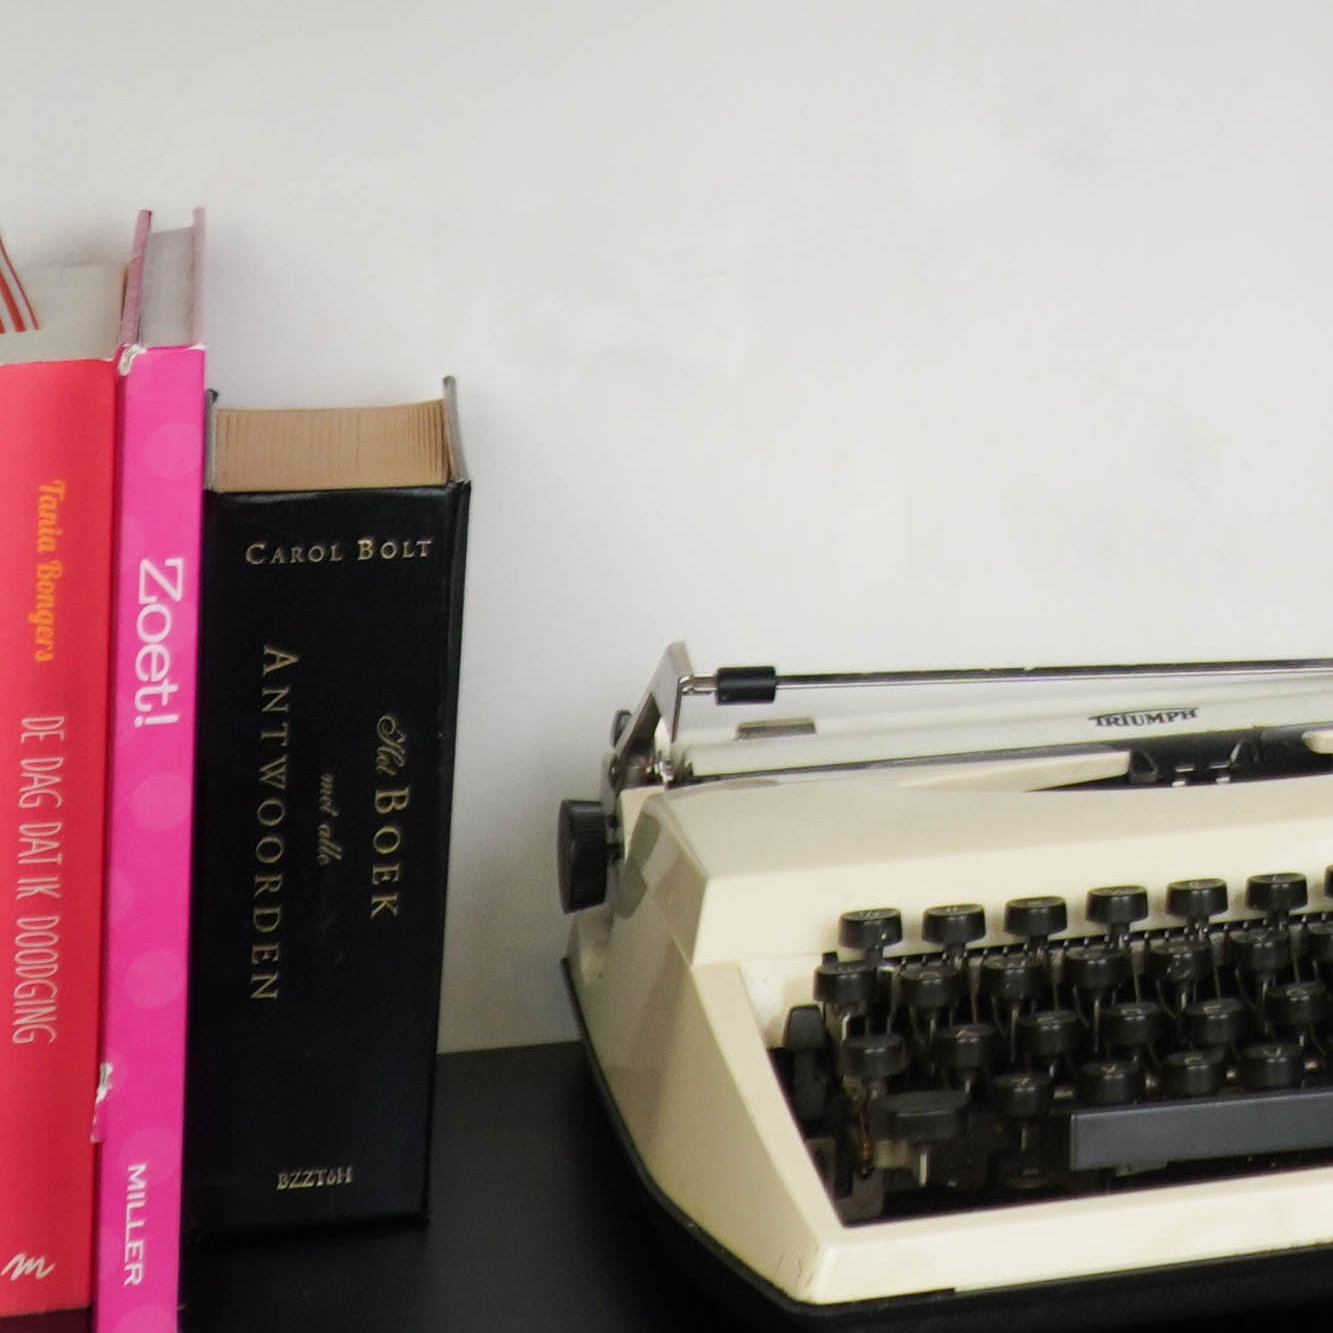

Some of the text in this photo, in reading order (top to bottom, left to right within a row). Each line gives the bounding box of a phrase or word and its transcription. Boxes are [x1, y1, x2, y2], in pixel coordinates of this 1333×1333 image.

[28, 479, 66, 662] Tania Bongers
[245, 536, 432, 565] CAROL BOLT
[133, 557, 184, 727] Zoet!
[1088, 708, 1199, 727] TRIUMPH
[12, 716, 65, 1044] DE DAG DAT IK DOODGING
[251, 644, 299, 1000] ANTWOORDEN
[318, 773, 343, 865] met alle
[370, 715, 410, 919] Het BOEK
[123, 1161, 147, 1287] MILLER
